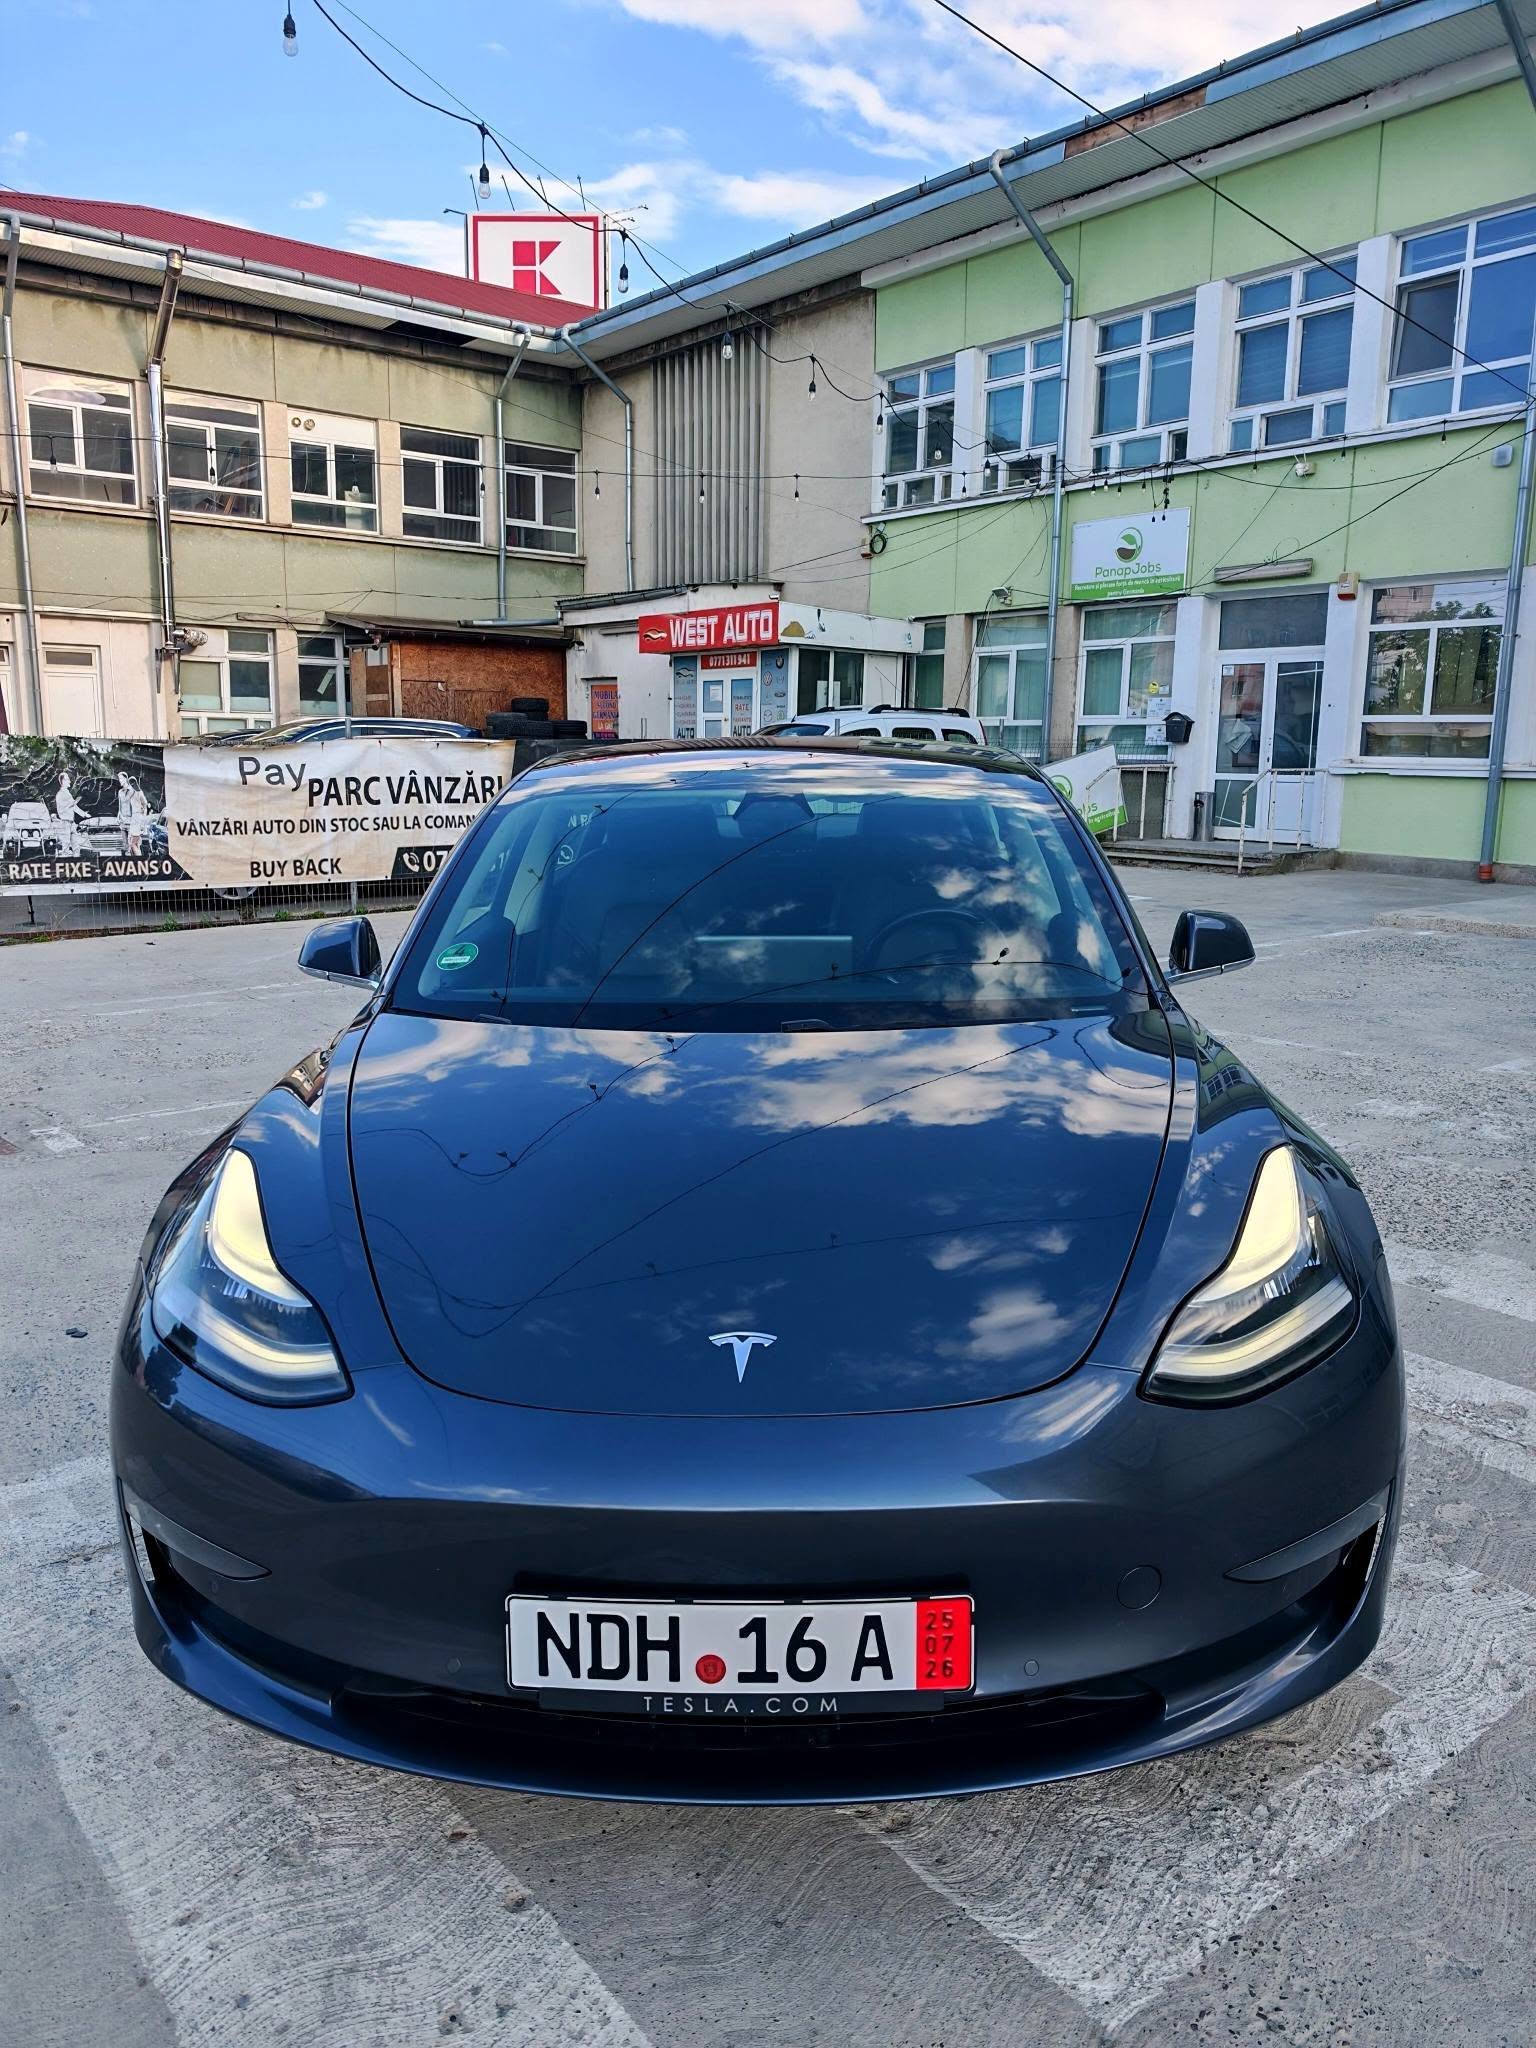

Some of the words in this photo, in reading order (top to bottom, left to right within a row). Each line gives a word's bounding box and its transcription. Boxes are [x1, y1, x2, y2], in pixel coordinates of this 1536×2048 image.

[1095, 562, 1162, 578] PanapJobs
[669, 615, 718, 648] WEST
[723, 609, 773, 644] AUTO
[677, 727, 695, 739] AUTO
[733, 725, 752, 737] AUTO
[238, 756, 306, 792] Pay
[308, 776, 381, 807] PARC
[176, 817, 248, 836] VÂNZĂRI
[253, 818, 295, 835] AUTO
[300, 818, 326, 834] DIN
[330, 817, 371, 832] STOC
[373, 816, 400, 831] SAU
[403, 816, 421, 830] LA
[424, 815, 476, 829] COMAN
[9, 862, 52, 880] RATE
[55, 861, 92, 878] FIXE
[104, 860, 158, 877] AVANS
[162, 860, 172, 875] 0
[250, 860, 288, 878] BUY
[293, 857, 342, 877] BACK
[423, 850, 449, 872] 07
[925, 1608, 954, 1631] 25
[536, 1610, 681, 1682] NDH
[737, 1616, 827, 1684] 16
[850, 1614, 894, 1682] A
[925, 1633, 955, 1655] 07
[925, 1657, 955, 1679] 26
[643, 1696, 838, 1713] TESLA.COM
